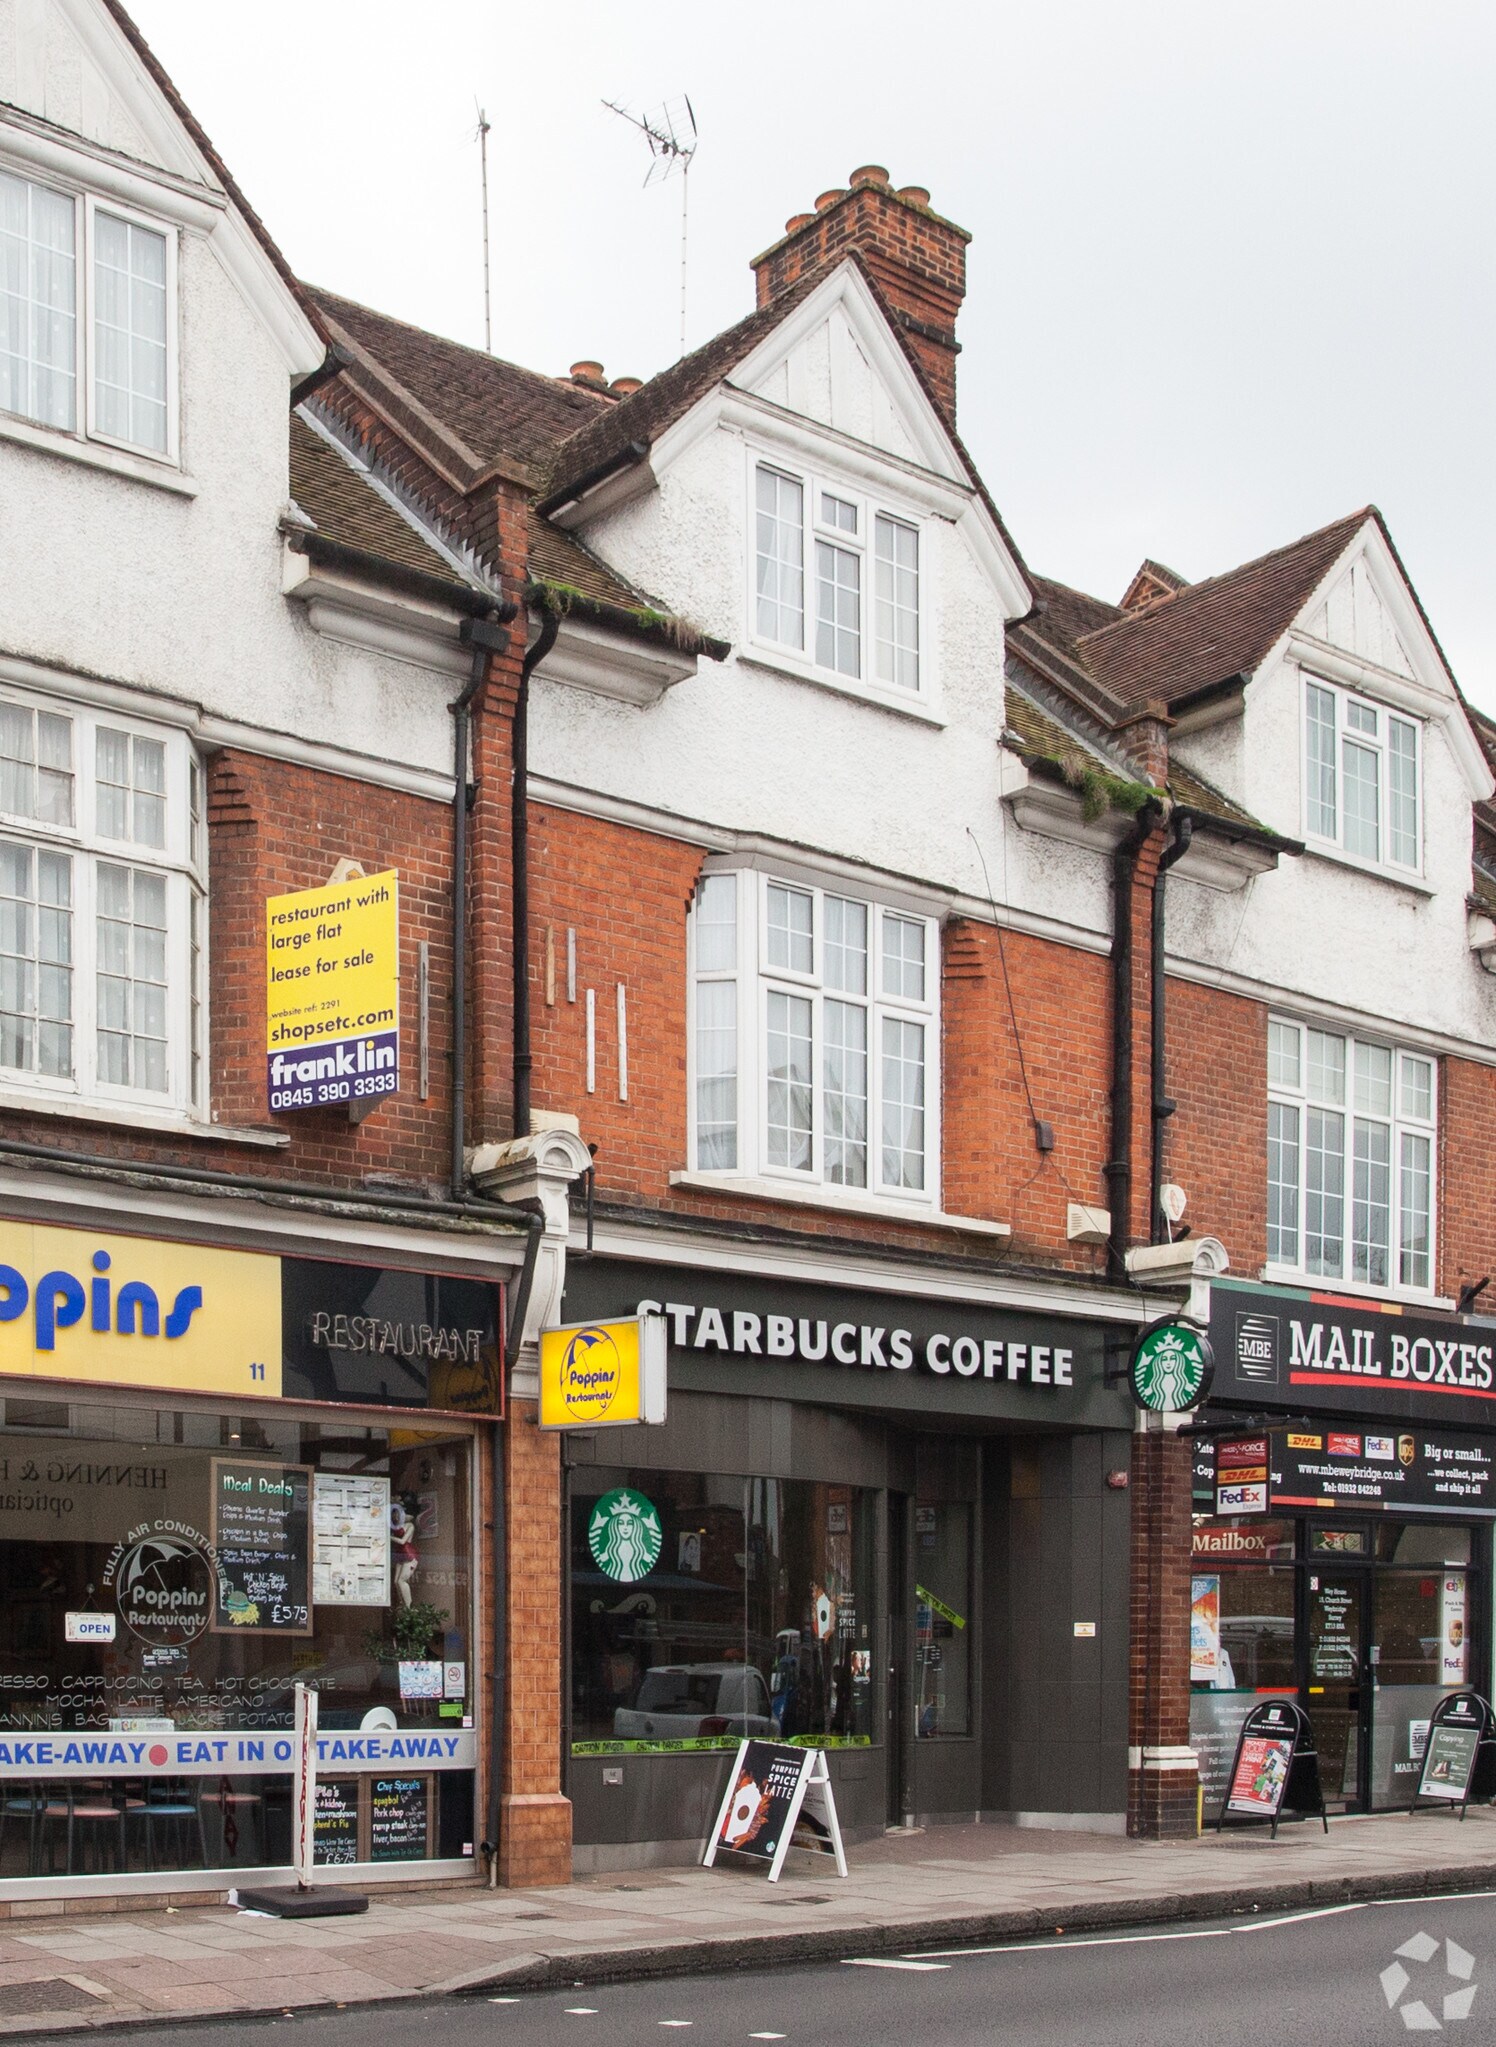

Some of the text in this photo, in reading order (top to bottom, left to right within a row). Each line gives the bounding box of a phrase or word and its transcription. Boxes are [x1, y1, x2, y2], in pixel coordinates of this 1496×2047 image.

[271, 885, 390, 926] restaurant with
[271, 924, 342, 950] large flat
[271, 949, 374, 983] lease for sale
[271, 1000, 341, 1019] website ref: 2291
[271, 1008, 394, 1042] shopsetc.com
[270, 1040, 395, 1087] franklin
[271, 1073, 396, 1109] 0845 390 3333
[313, 1311, 484, 1362] RESTAURANT
[1242, 1339, 1272, 1359] MBE
[1289, 1320, 1494, 1389] MAIL BOXES
[925, 1333, 1074, 1386] COFFEE
[249, 1364, 266, 1381] 11
[570, 1367, 615, 1389] Poppins
[1292, 1436, 1317, 1447] DHL
[1367, 1438, 1389, 1452] FedEx
[1424, 1444, 1491, 1462] Big or small...
[1225, 1469, 1259, 1480] DHL
[1298, 1463, 1405, 1482] www.mbeweybridge.co.uk
[1445, 1468, 1471, 1481] collect,
[1471, 1470, 1489, 1482] pack
[223, 1475, 293, 1497] Meal Deals
[1323, 1482, 1337, 1492] Tel:
[1337, 1483, 1357, 1493] 01932
[1435, 1482, 1481, 1496] and ship it all
[1220, 1487, 1260, 1504] FedEx
[1192, 1532, 1266, 1552] Mailbox
[102, 1540, 125, 1586] FULLY
[127, 1522, 151, 1543] AIR
[133, 1585, 206, 1610] Poppins
[129, 1610, 206, 1626] Restaurants
[838, 1618, 856, 1627] SPICE
[79, 1623, 111, 1634] OPEN
[62, 1676, 164, 1690] CAPPUCCINO
[175, 1677, 204, 1690] TEA
[215, 1677, 244, 1690] HOT
[248, 1677, 336, 1690] CHOCOATE
[46, 1695, 265, 1708] MOCHA LATTE AMERICANO
[1439, 1733, 1465, 1744] Copying
[177, 1742, 226, 1764] EAT
[238, 1741, 264, 1762] IN
[274, 1740, 294, 1761] O
[316, 1737, 459, 1760] TAKE-AWAY
[770, 1763, 800, 1776] PUMPKIN
[767, 1773, 797, 1787] SPICE
[763, 1784, 794, 1800] LATTE
[374, 1807, 404, 1818] Pork chop
